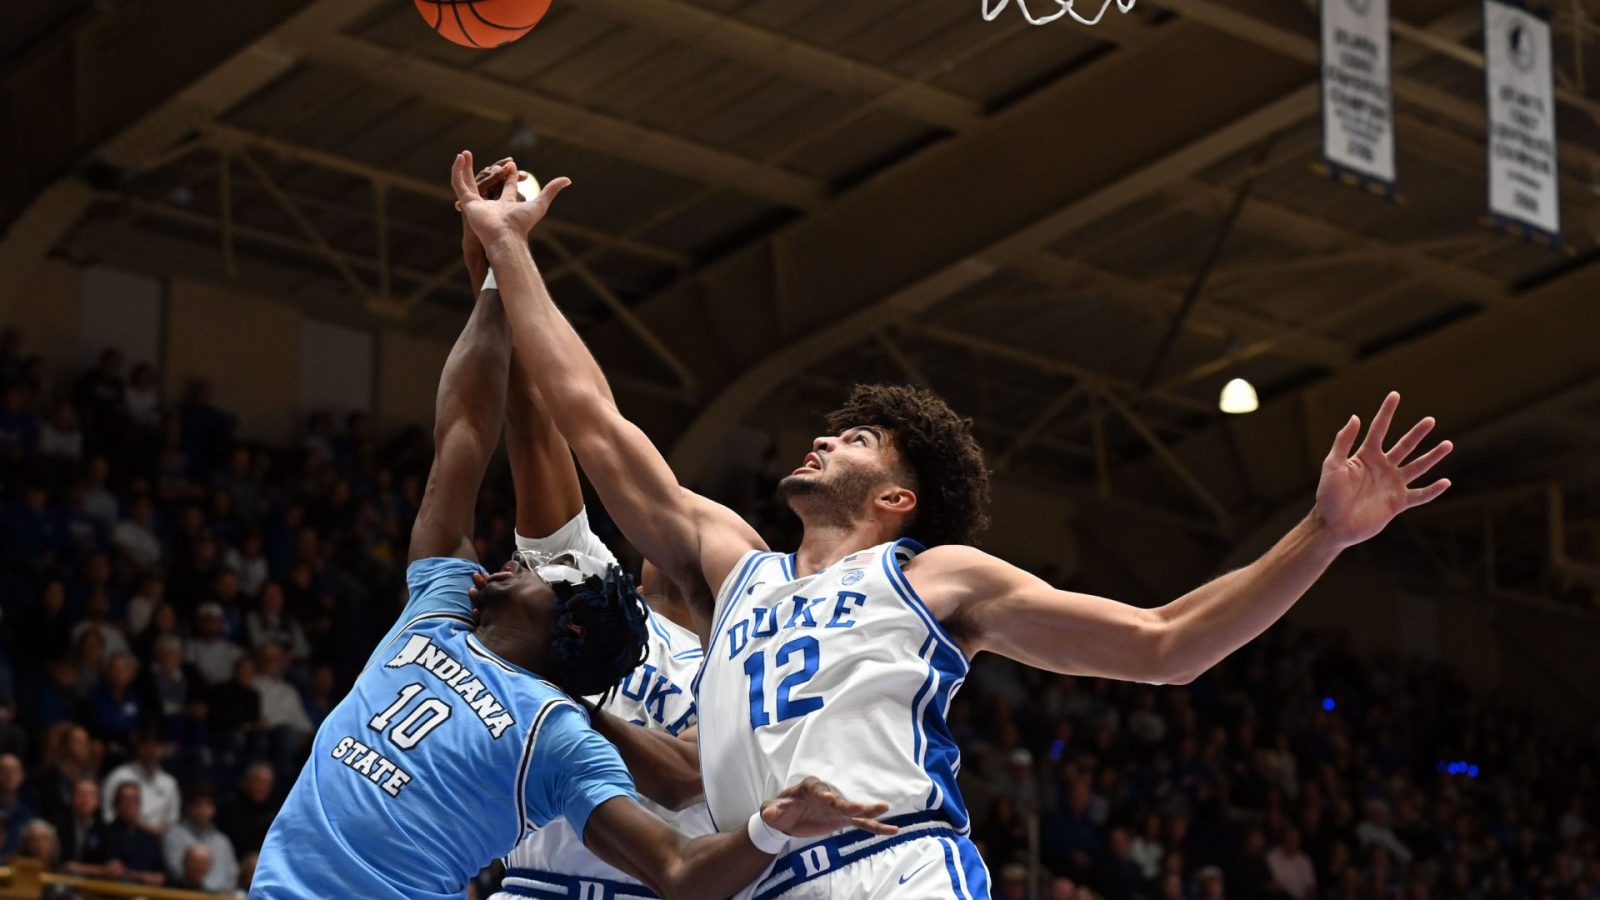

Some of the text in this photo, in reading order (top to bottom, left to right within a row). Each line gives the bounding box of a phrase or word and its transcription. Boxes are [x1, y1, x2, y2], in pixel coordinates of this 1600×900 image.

[728, 591, 867, 661] DUKE
[367, 682, 452, 751] 10
[384, 634, 516, 740] INDIANA
[619, 663, 697, 737] UK
[744, 635, 825, 733] 12
[331, 736, 413, 798] STATE
[799, 845, 831, 878] D
